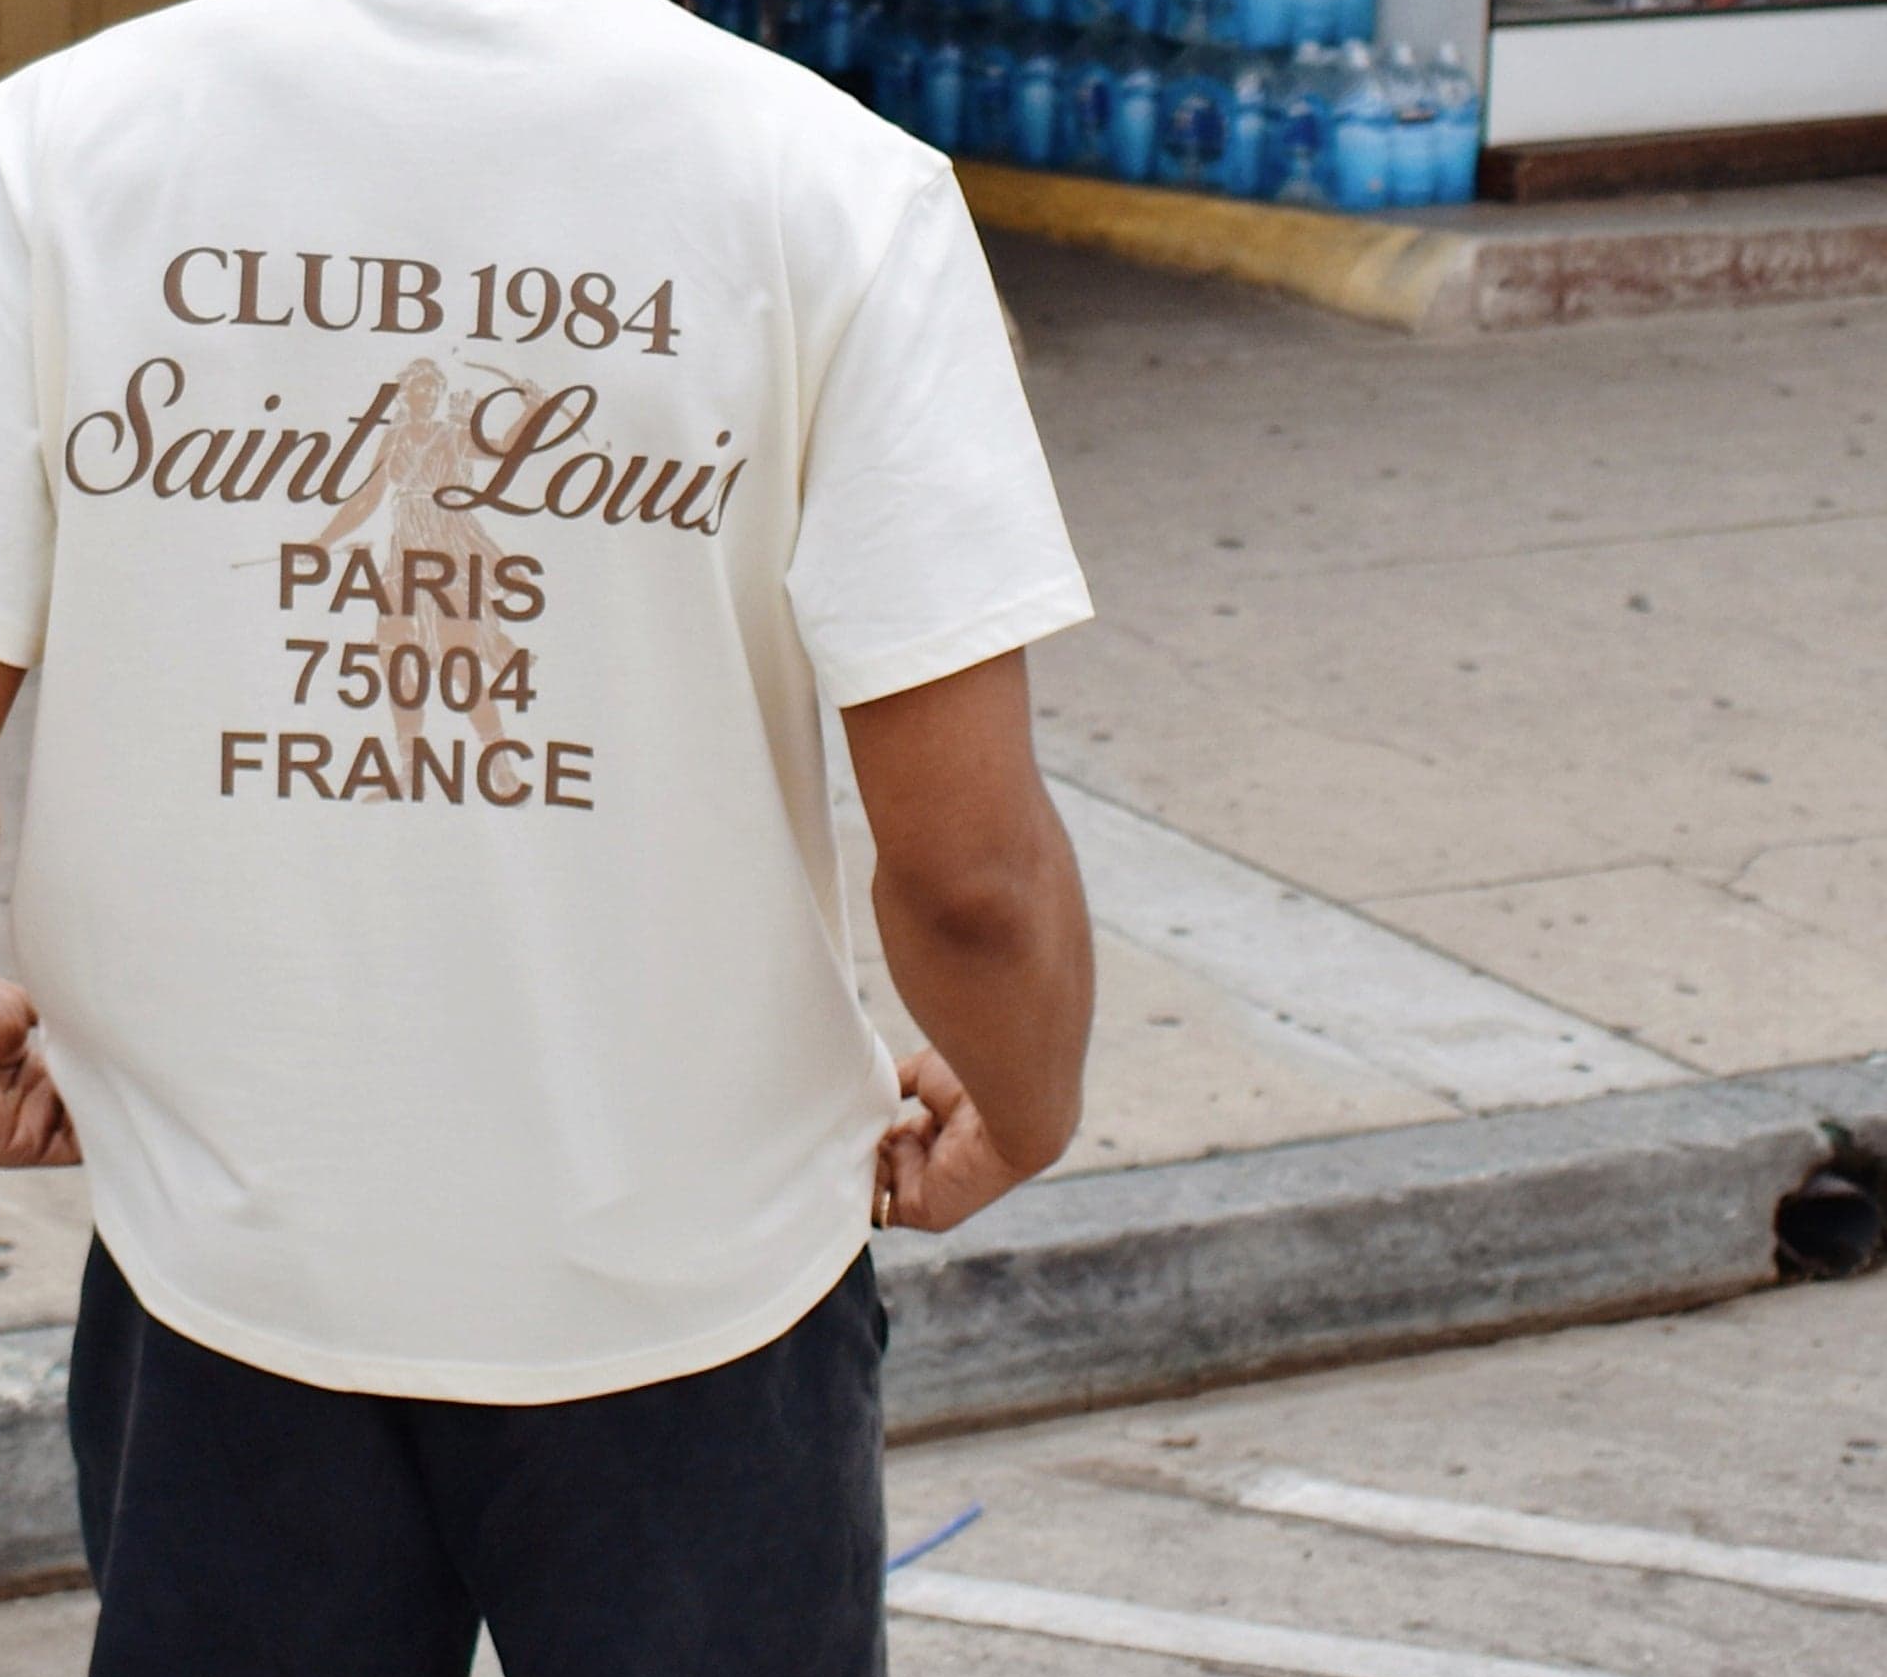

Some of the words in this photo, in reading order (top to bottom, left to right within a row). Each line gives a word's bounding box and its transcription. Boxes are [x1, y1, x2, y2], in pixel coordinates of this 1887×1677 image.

[162, 246, 445, 335] CLUB
[466, 263, 681, 357] 1984
[64, 357, 401, 506] Saint
[278, 543, 546, 622] PARIS
[284, 638, 537, 714] 75004
[219, 731, 595, 811] FRANCE
